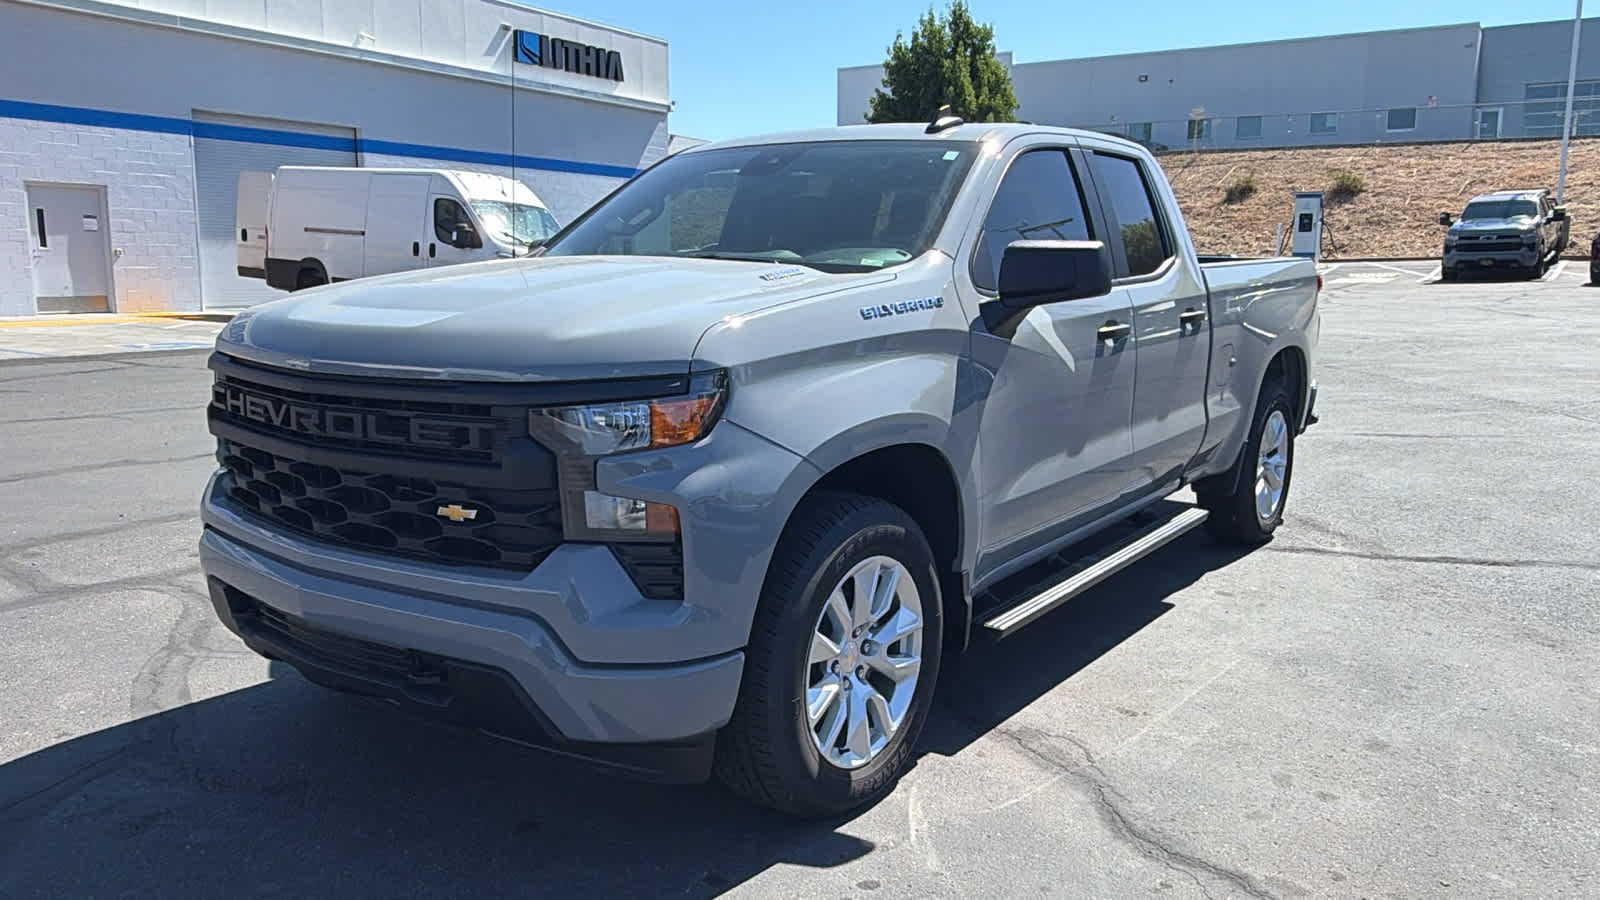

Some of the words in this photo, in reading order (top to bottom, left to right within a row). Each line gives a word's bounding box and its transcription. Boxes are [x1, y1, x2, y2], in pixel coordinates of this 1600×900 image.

[540, 35, 624, 82] LITHIA
[860, 296, 944, 320] SILVERADO
[212, 385, 496, 449] CHEVROLET
